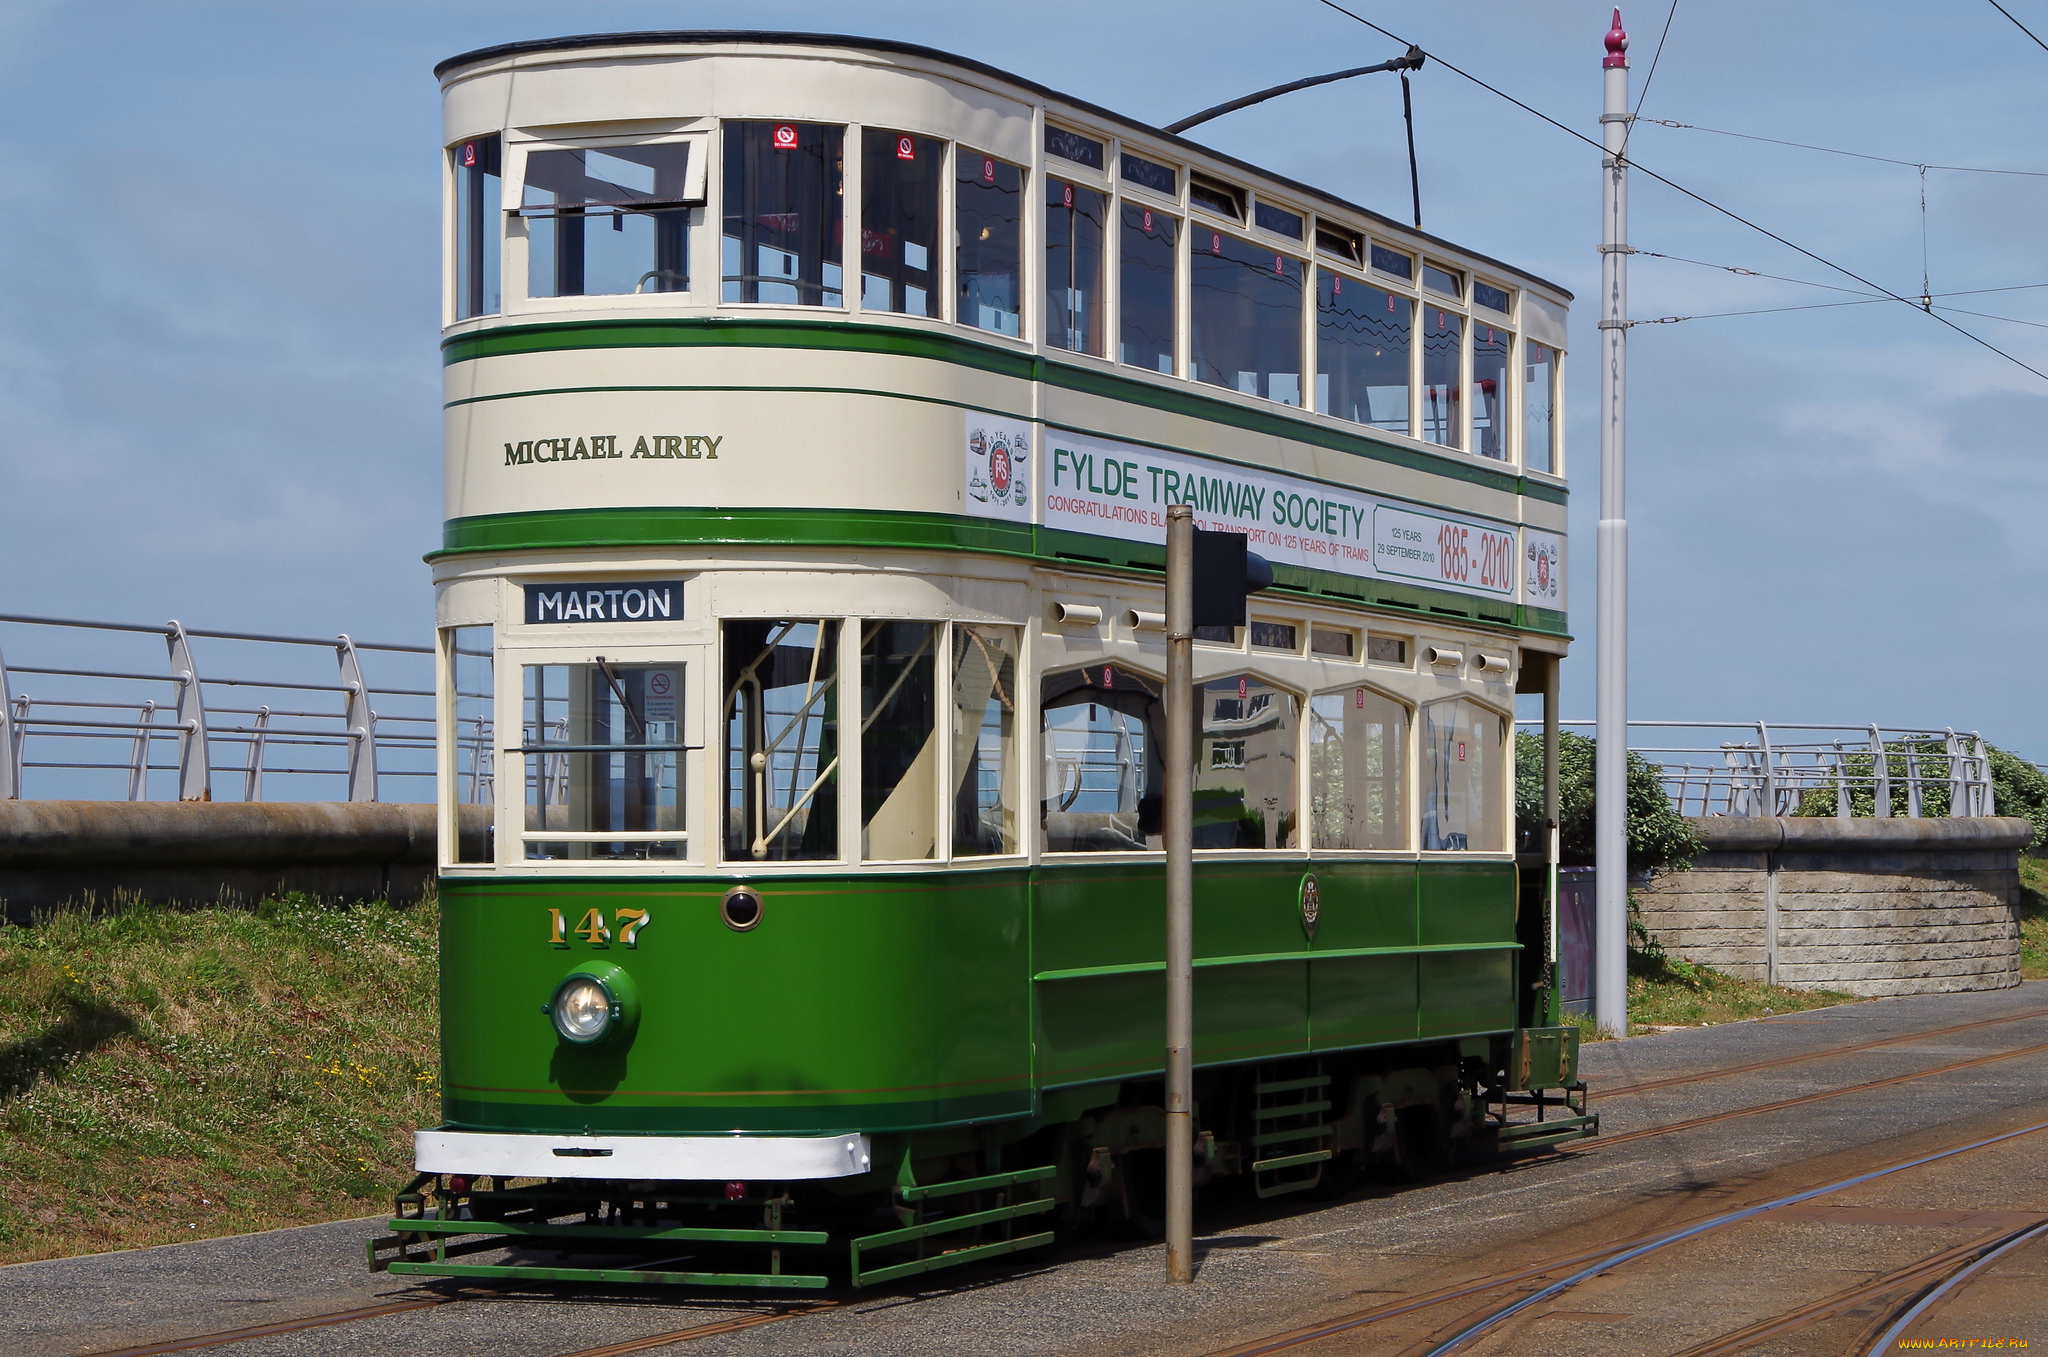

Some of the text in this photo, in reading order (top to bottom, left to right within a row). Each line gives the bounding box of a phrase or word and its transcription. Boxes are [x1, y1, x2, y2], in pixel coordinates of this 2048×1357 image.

[504, 435, 723, 466] MICHAEL AIREY
[1054, 448, 1365, 540] FYLDE TRAMWAY SOCIETY
[1047, 494, 1148, 525] CONGRATULATIONS
[1268, 531, 1282, 546] ON
[1283, 535, 1297, 549] 125
[1299, 537, 1326, 555] YEARS
[1328, 542, 1340, 556] OF
[1341, 544, 1369, 562] TRAMS
[1391, 527, 1422, 542] 125 YEARS
[1377, 543, 1435, 563] 29 SEPTEMBER 2010
[1437, 523, 1468, 582] 1885
[1481, 532, 1510, 589] 2010
[538, 588, 671, 621] MARTON
[547, 908, 651, 949] 147
